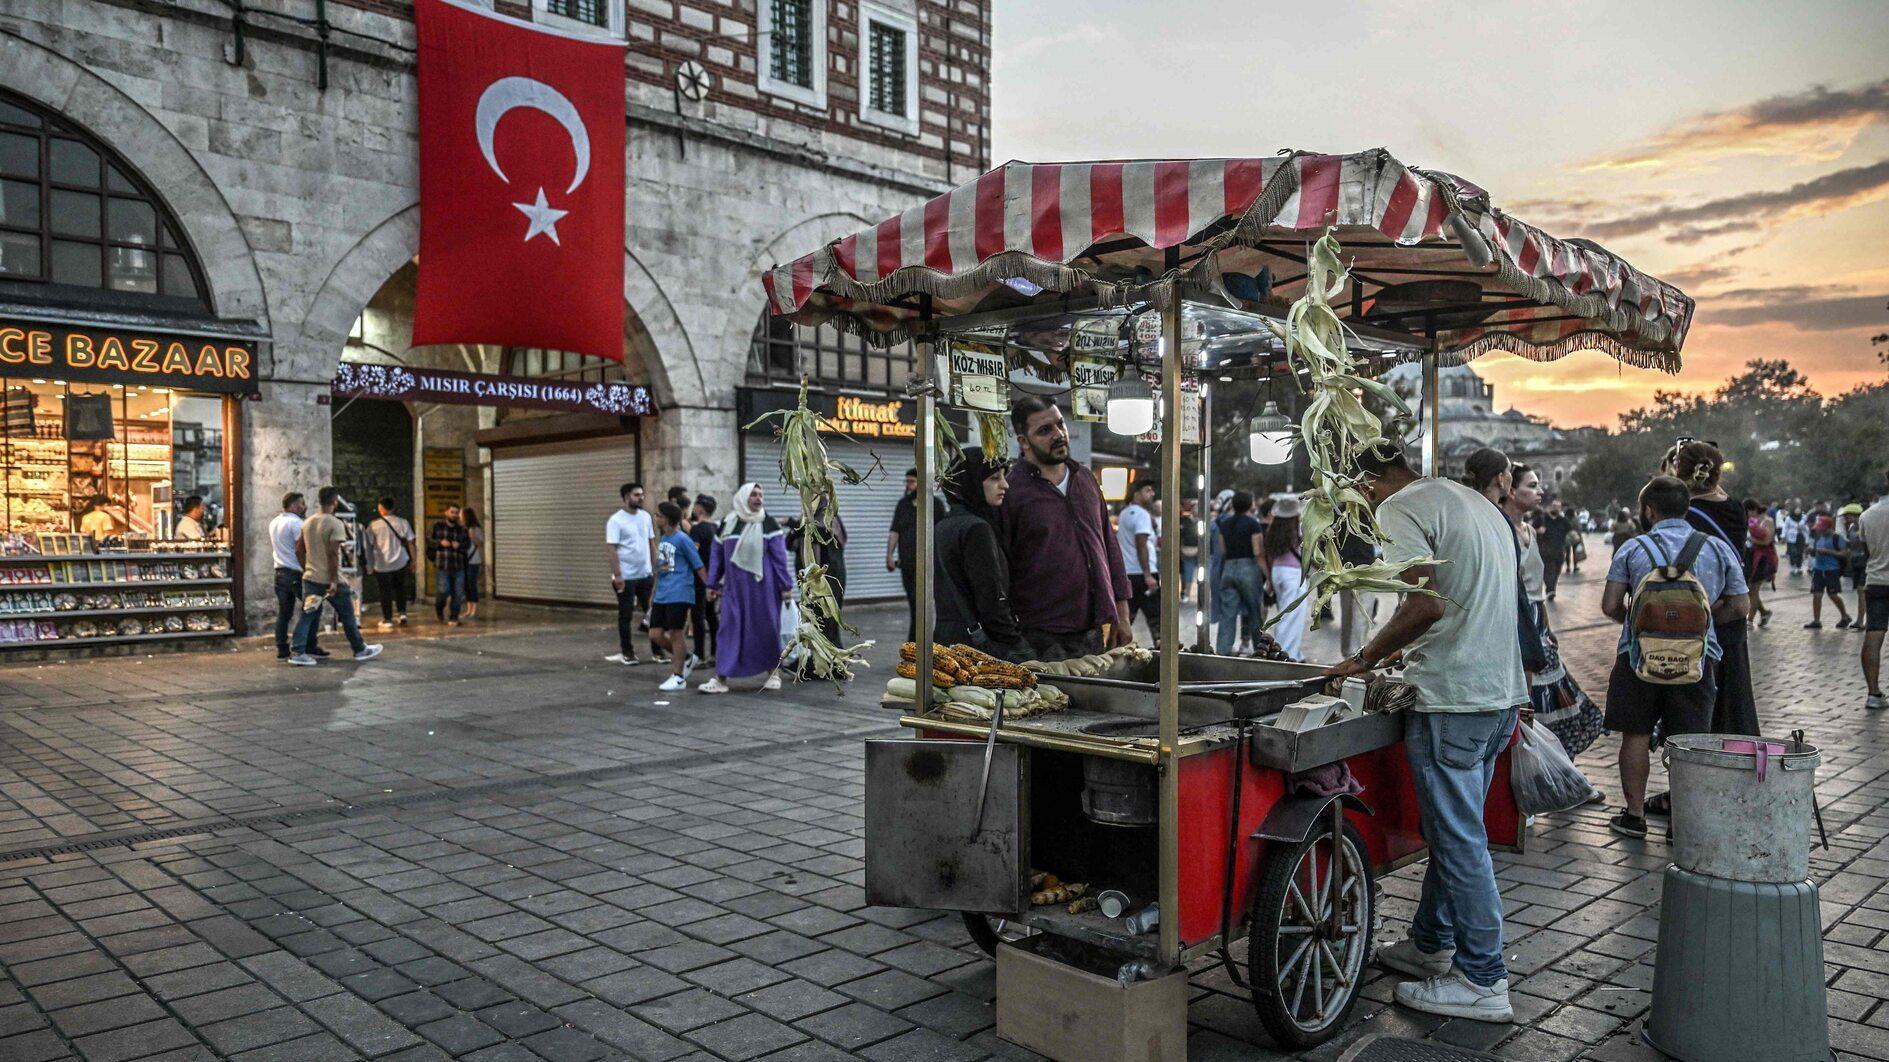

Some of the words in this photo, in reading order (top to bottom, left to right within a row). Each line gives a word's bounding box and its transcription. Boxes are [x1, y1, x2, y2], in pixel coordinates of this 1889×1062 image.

[67, 334, 250, 379] BAZAAR
[953, 352, 974, 374] KÖZ
[977, 358, 1004, 378] MISIR
[1075, 364, 1092, 385] SÜT
[420, 376, 471, 393] MISIR
[474, 380, 539, 400] ÇARŞISI
[541, 386, 583, 403] (1664)
